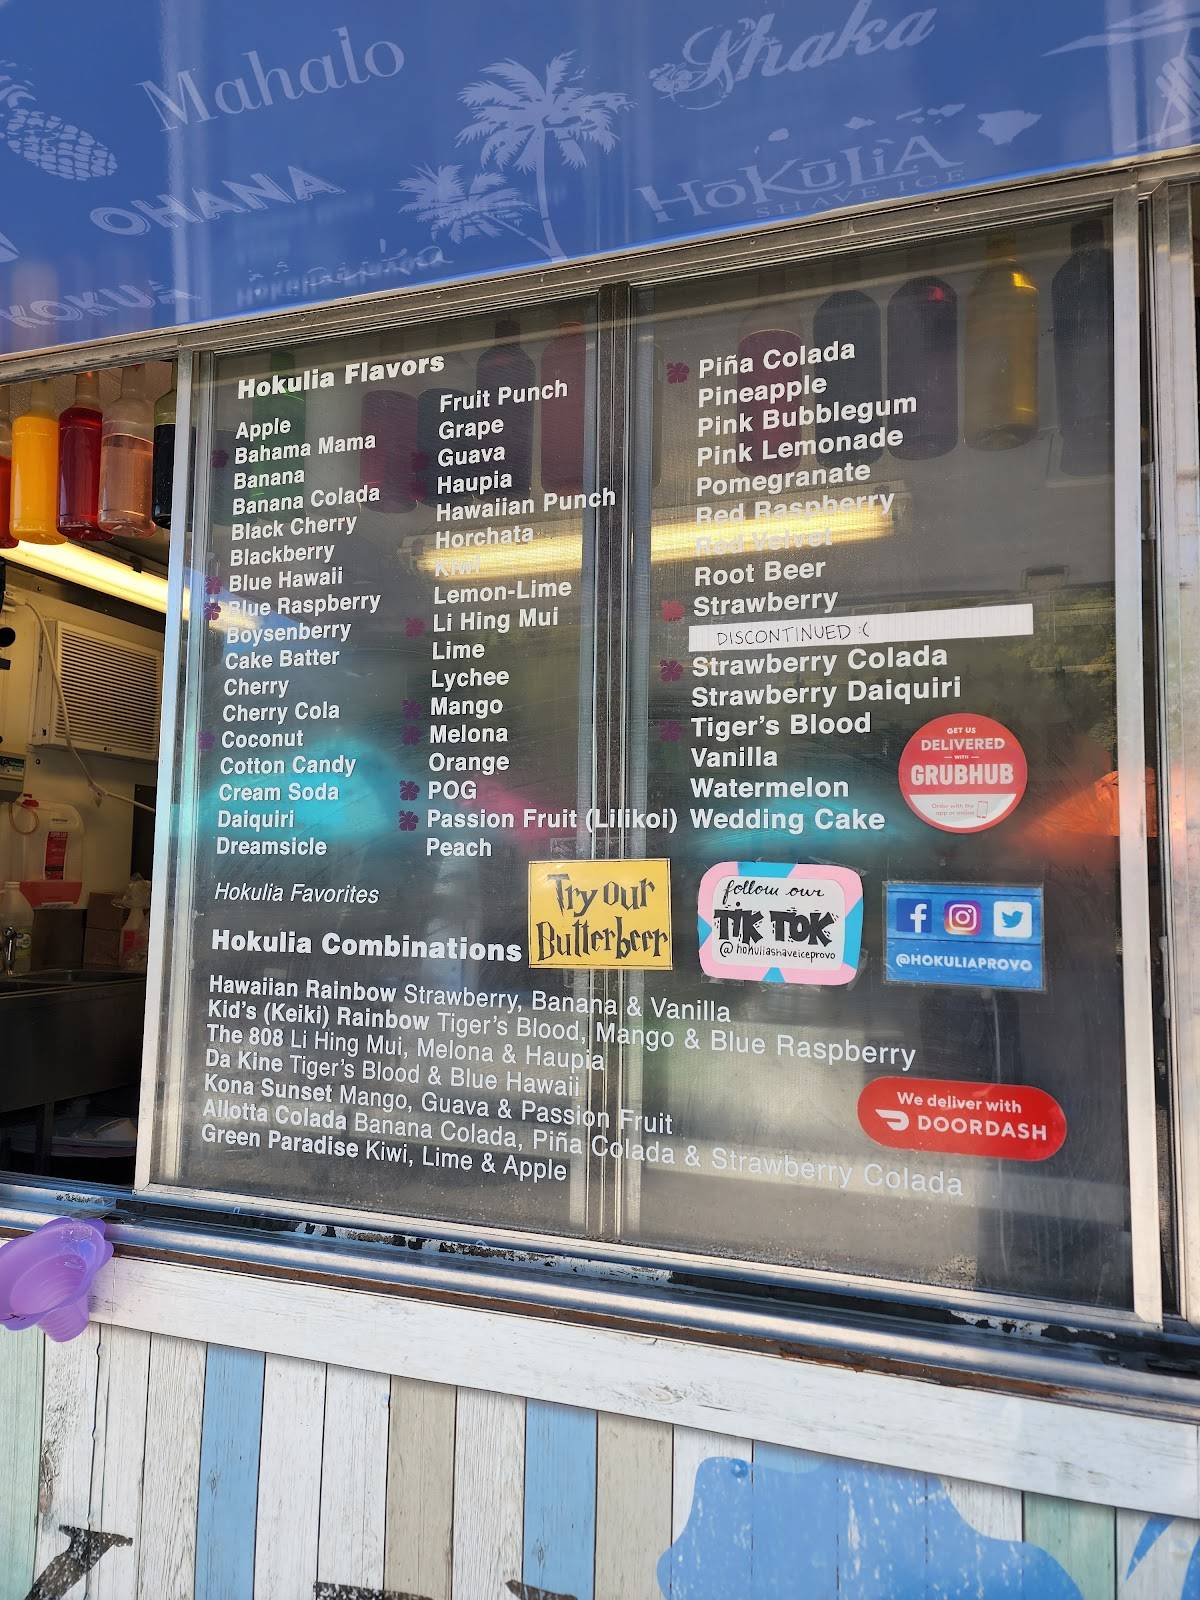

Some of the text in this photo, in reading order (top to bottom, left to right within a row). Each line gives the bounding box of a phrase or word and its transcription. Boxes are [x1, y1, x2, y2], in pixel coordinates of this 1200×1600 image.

[136, 26, 404, 133] Mahalo
[90, 165, 346, 236] OHANA
[699, 340, 855, 379] Piña Colada
[238, 354, 444, 399] Hokulia Flavors
[439, 379, 568, 412] Fruit Punch
[699, 375, 827, 408] Pineapple
[236, 418, 291, 441] Apple
[438, 418, 504, 440] Grape
[698, 396, 917, 438] Pink Bubblegum
[235, 434, 376, 464] Bahama Mama
[437, 446, 506, 467] Guava
[697, 426, 904, 467] Pink Lemonade
[234, 470, 305, 490] Banana
[437, 470, 512, 495] Haupia
[697, 463, 871, 497] Pomegranate
[233, 485, 380, 516] Banana Colada
[436, 487, 616, 522] Hawaiian Punch
[696, 493, 895, 526] Red Raspberry
[231, 516, 357, 541] Black Cherry
[435, 526, 534, 549] Horchata
[696, 528, 833, 557] Red Velvet
[230, 545, 334, 567] Blackberry
[434, 556, 481, 577] Kiwi
[229, 567, 343, 593] Blue Hawaii
[694, 560, 826, 587] Root Beer
[434, 580, 572, 605] Lemon-Lime
[693, 591, 839, 617] Strawberry
[230, 594, 381, 617] Blue Raspberry
[433, 607, 559, 633] Li Hing Mui
[227, 622, 351, 647] Boysenberry
[717, 624, 852, 647] DISCONTINUED
[225, 650, 340, 670] Cake Batter
[432, 641, 485, 660] Lime
[692, 644, 948, 678] Strawberry Colada
[224, 678, 289, 698] Cherry
[431, 668, 510, 692] Lychee
[692, 676, 961, 708] Strawberry Daiquiri
[223, 701, 340, 724] Cherry Cola
[430, 697, 503, 719] Mango
[221, 729, 304, 748] Coconut
[430, 725, 508, 744] Melona
[691, 711, 871, 742] Tiger’s Blood
[947, 727, 963, 735] GET
[921, 737, 1006, 751] DELIVERED
[220, 755, 356, 777] Cotton Candy
[428, 752, 510, 775] Orange
[691, 747, 778, 768] Vanilla
[910, 763, 1014, 786] GRUBHUB
[219, 782, 339, 801] Cream Soda
[428, 780, 477, 800] POG
[691, 777, 849, 798] Watermelon
[217, 809, 294, 832] Daiquiri
[427, 808, 678, 833] Passion Fruit (Lilikoi)
[690, 808, 885, 834] Wedding Cake
[216, 836, 327, 856] Dreamsicle
[426, 837, 492, 856] Peach
[214, 882, 380, 903] Hokulia Favorites
[547, 873, 598, 918] Try
[722, 880, 824, 905] follow our
[212, 929, 522, 962] Hokulia Combinations
[536, 915, 668, 962] Butterbeer
[895, 952, 1034, 973] @HOKULIAPROVO
[209, 975, 731, 1023] Hawaiian Rainbow Strawberry, Banana Vanilla
[208, 999, 916, 1071] Kid’s (Keiki) Rainbow Tiger’s Blood, Mango Blue Raspberry
[207, 1024, 604, 1073] The 808 Li Hing Mui, Melona Haupia
[205, 1049, 581, 1097] Da Kine Tiger’s Blood Blue Hawaii
[204, 1074, 673, 1135] Kona Sunset Mango, Guava Passion Fruit
[897, 1091, 1022, 1115] We deliver with
[917, 1115, 1047, 1142] DOORDASH
[201, 1123, 567, 1183] Green Paradise Kiwi, Lime Apple
[203, 1099, 963, 1197] Allotta Colada Banana Colada, Piña Colada Strawberry Colada
